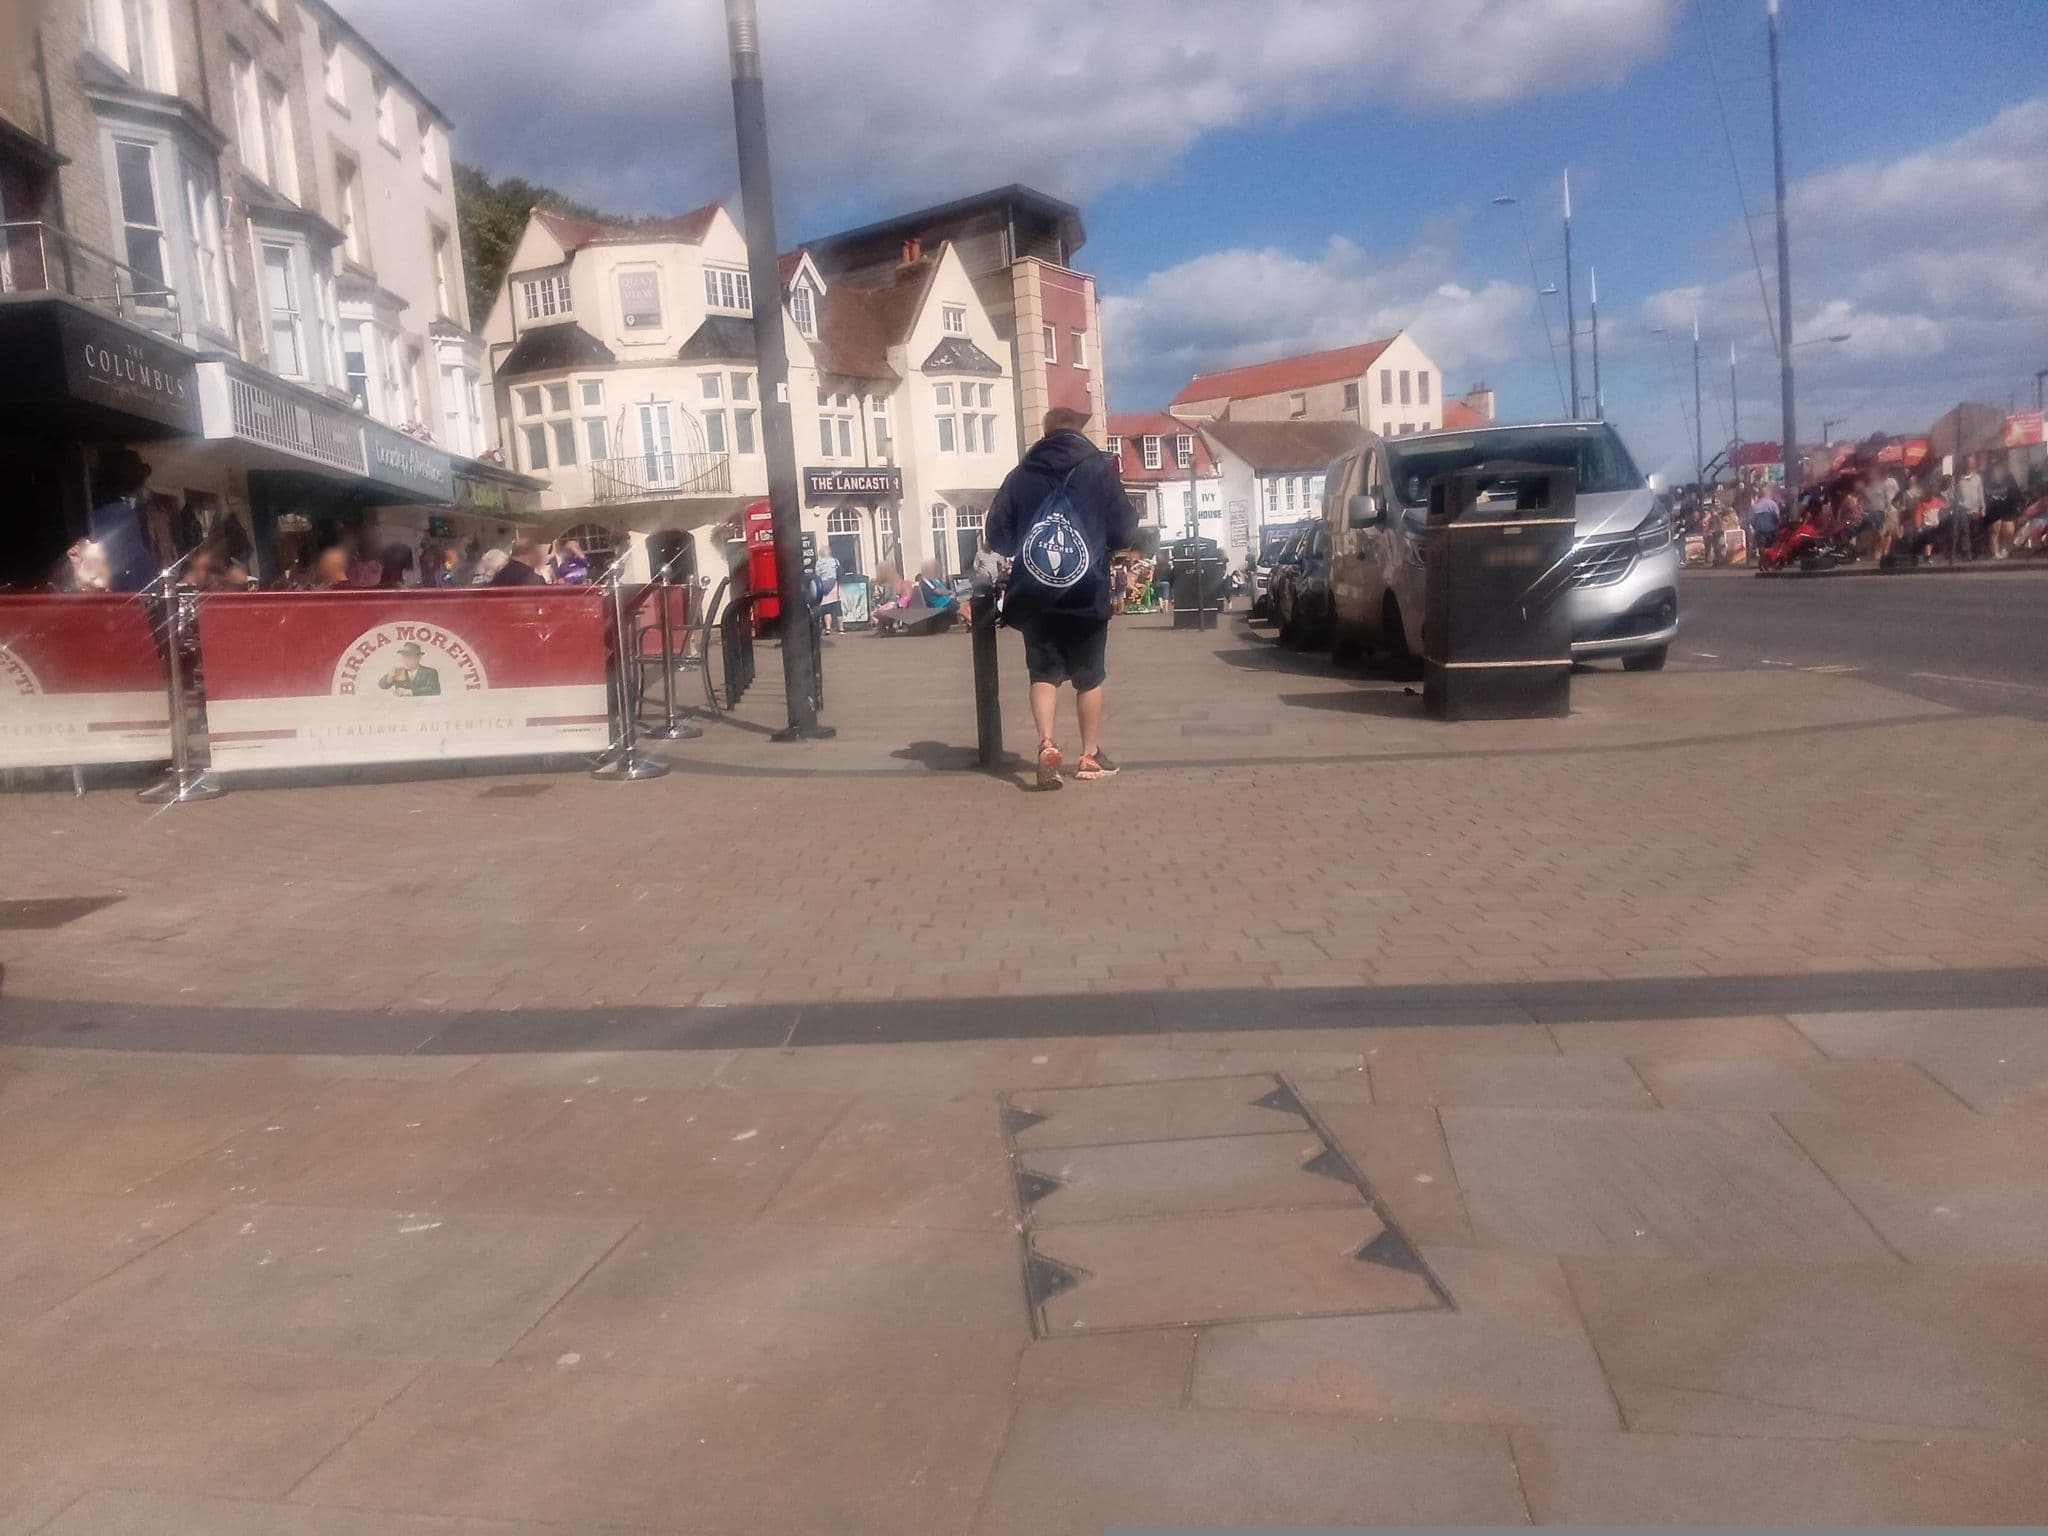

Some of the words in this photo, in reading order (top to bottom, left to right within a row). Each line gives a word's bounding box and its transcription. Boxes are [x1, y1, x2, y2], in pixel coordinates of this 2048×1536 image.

[85, 344, 184, 399] COLUMBUS
[811, 477, 833, 490] THE
[837, 477, 899, 490] LANCASTR
[1202, 493, 1216, 503] IVY
[1198, 510, 1222, 519] HOUSE
[340, 632, 391, 695] BIRRA
[396, 626, 480, 690] MORETTI
[420, 719, 514, 733] AUTENTICA
